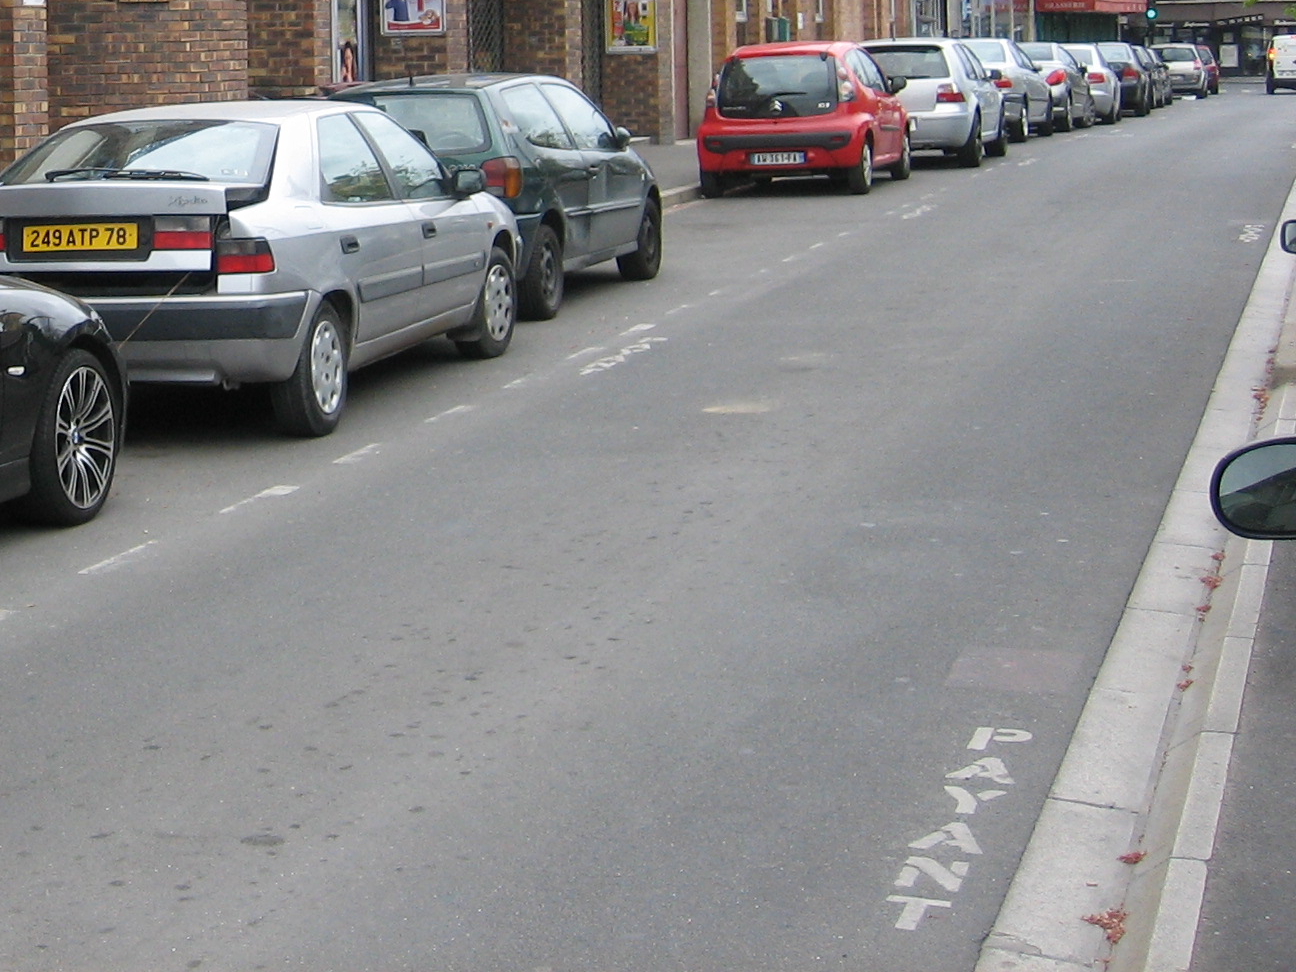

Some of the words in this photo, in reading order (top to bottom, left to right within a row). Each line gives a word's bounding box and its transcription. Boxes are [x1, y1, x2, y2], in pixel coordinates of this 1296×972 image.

[30, 230, 61, 247] 249
[66, 229, 99, 246] ATP
[105, 227, 127, 246] 78
[886, 726, 1033, 931] PAYANT
